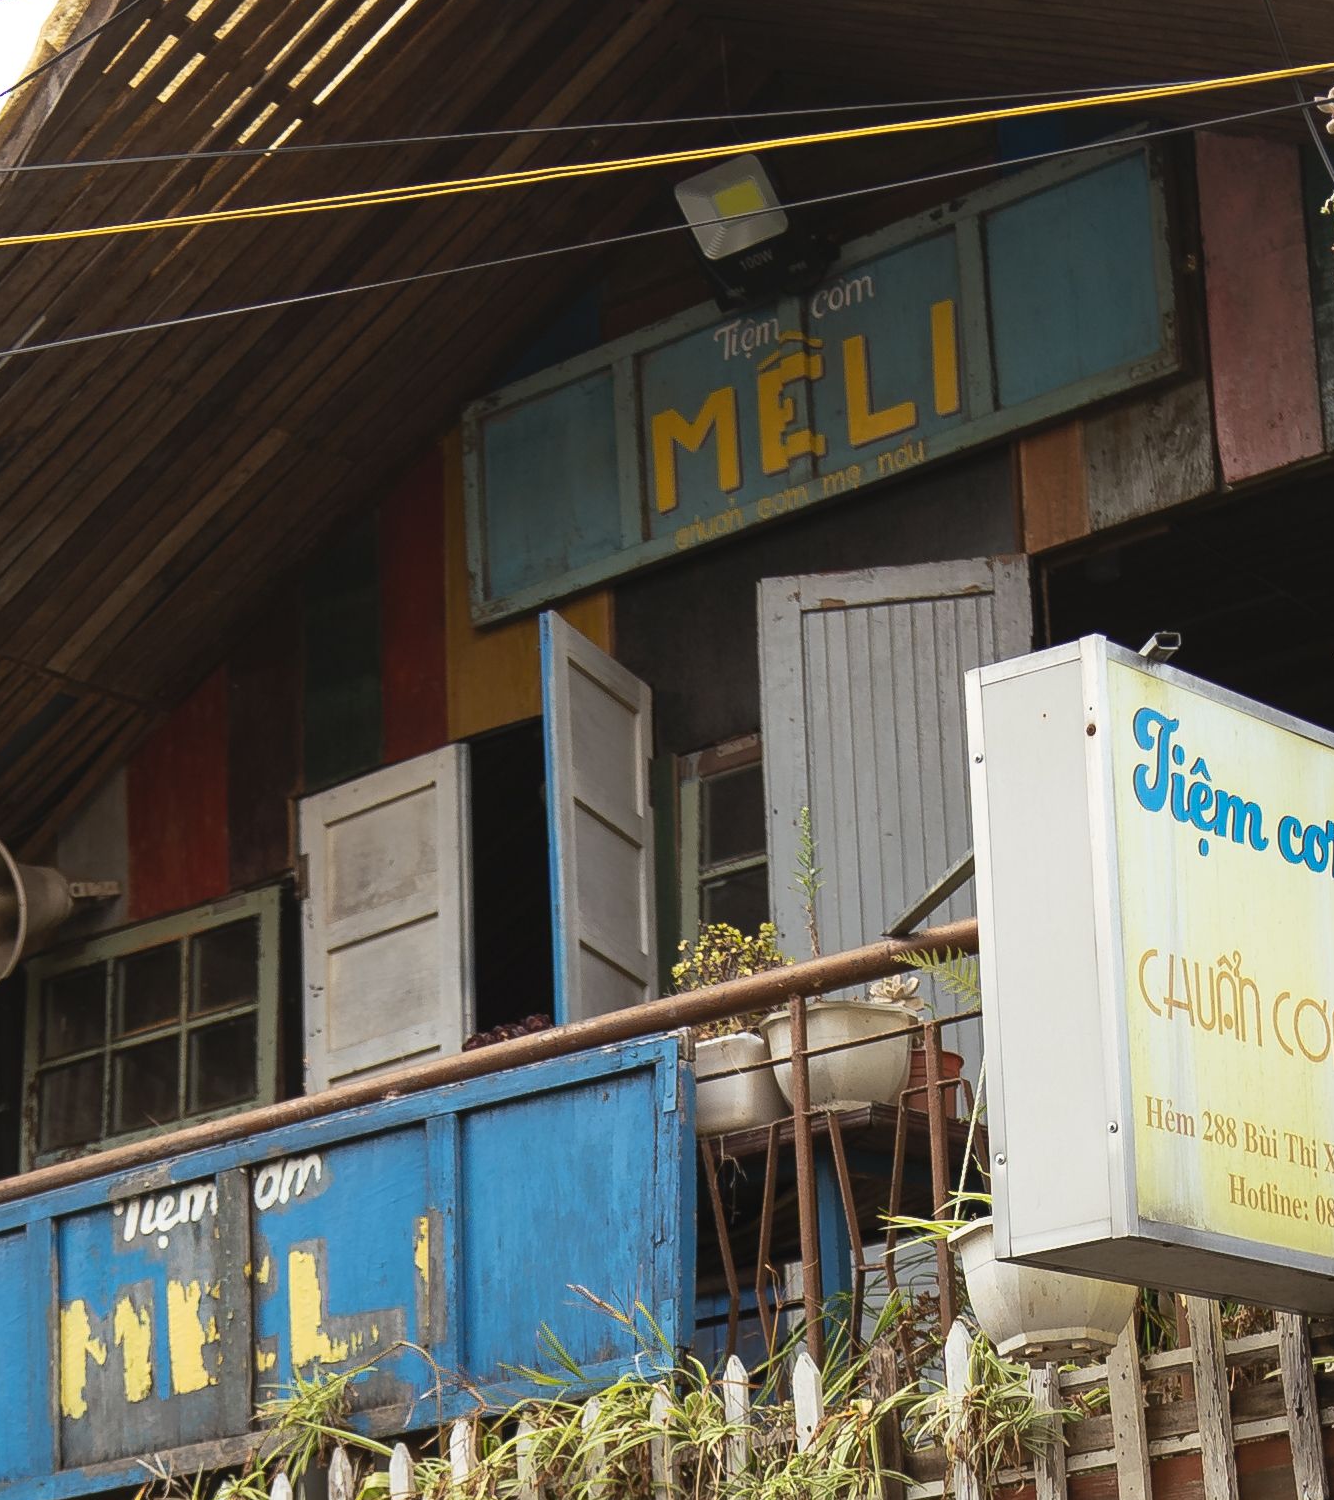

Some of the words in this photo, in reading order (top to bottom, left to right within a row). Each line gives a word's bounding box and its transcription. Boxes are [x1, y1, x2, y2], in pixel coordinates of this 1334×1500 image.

[713, 318, 780, 361] Tiệm
[1133, 707, 1269, 857] Tiệm
[1146, 1095, 1196, 1139] Hẻm
[1202, 1111, 1238, 1150] 288
[1243, 1120, 1279, 1161] Bùi
[1284, 1131, 1318, 1179] Thị
[1228, 1173, 1309, 1222] Hotline:
